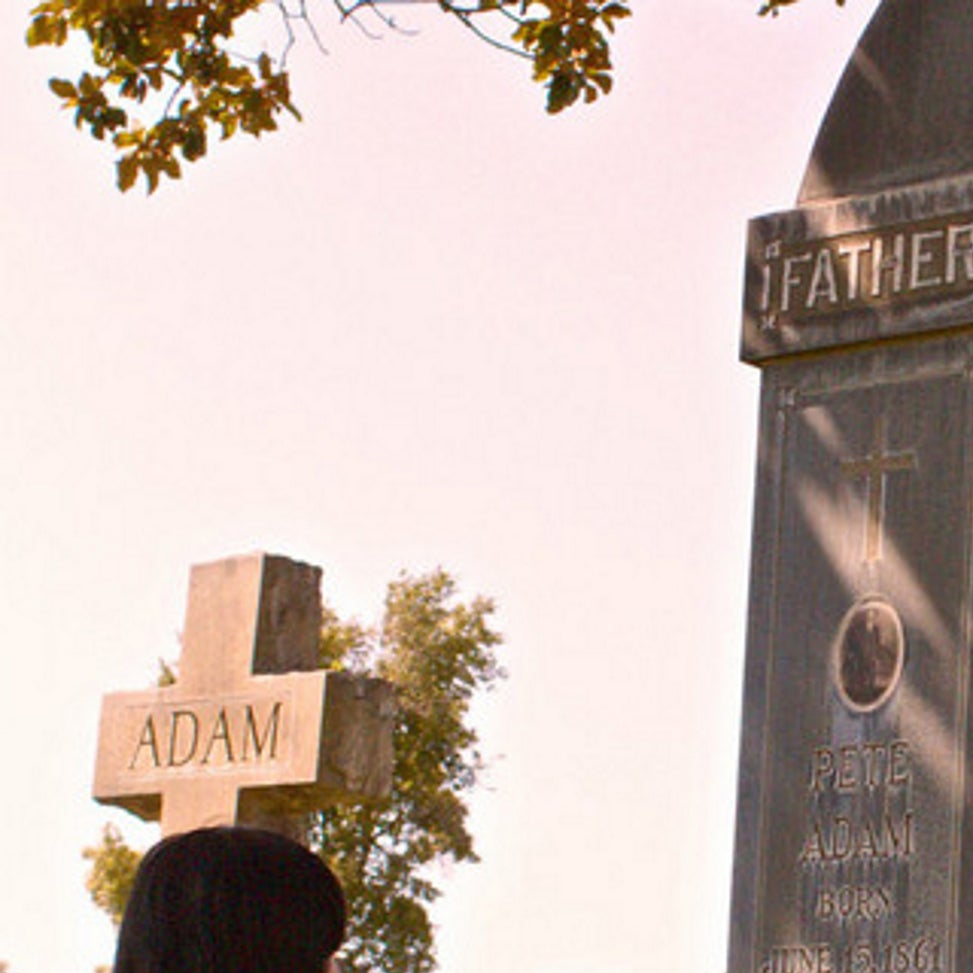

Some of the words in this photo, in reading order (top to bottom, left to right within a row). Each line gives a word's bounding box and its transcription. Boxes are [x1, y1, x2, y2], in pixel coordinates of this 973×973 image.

[127, 701, 282, 770] ADAM
[811, 741, 911, 791] PETE
[800, 813, 913, 862] ADAM
[816, 886, 892, 919] BORN
